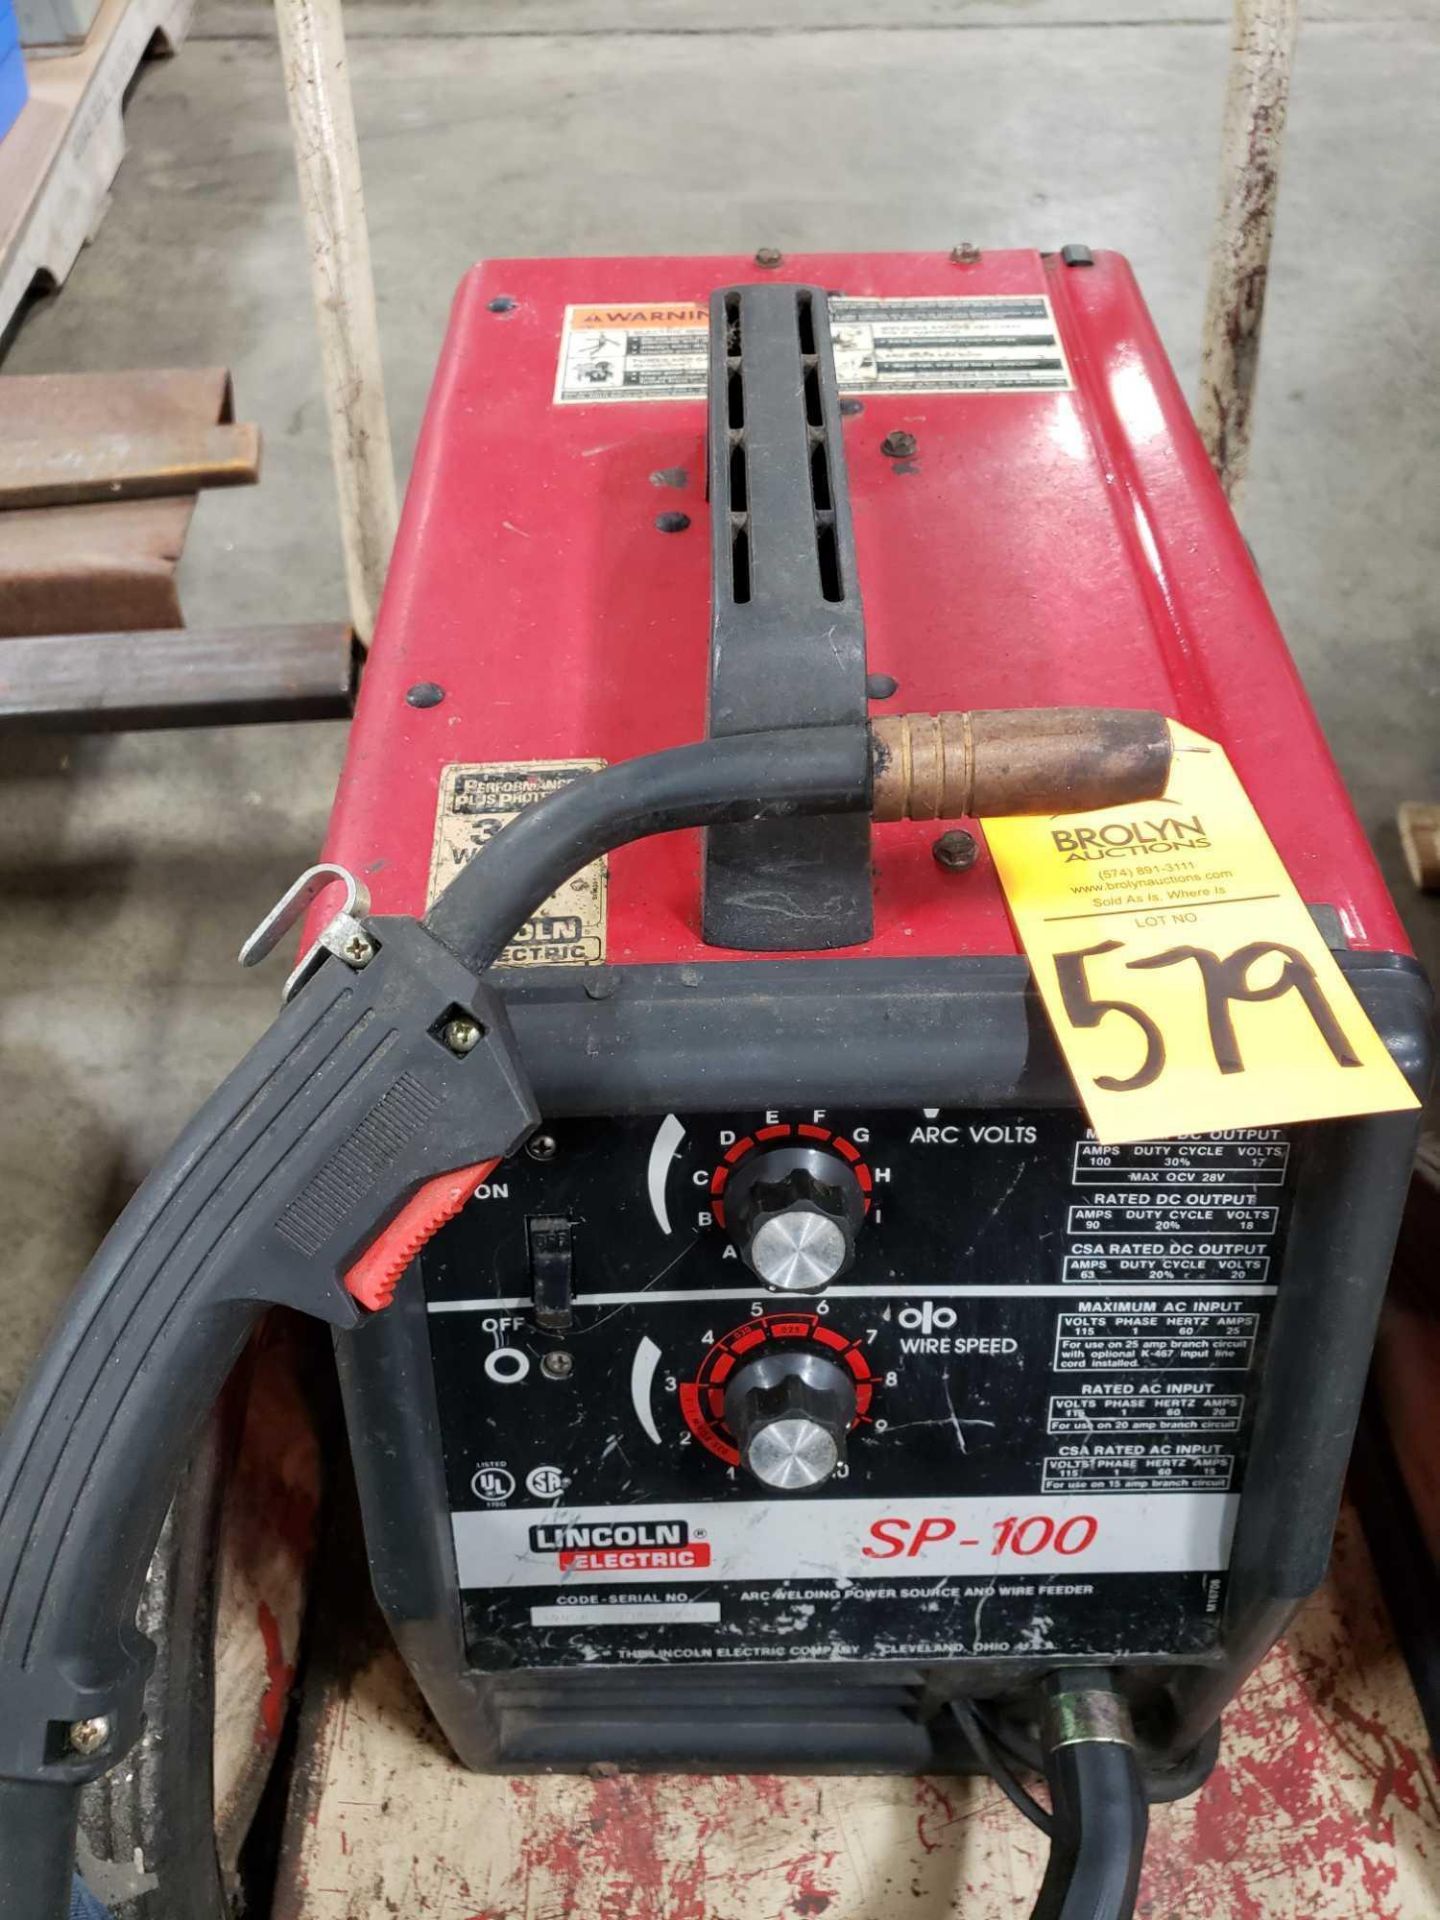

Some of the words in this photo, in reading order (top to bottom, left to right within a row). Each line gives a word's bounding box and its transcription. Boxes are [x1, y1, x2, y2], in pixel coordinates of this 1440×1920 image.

[607, 310, 709, 322] WARNIN
[470, 818, 502, 845] 3
[1051, 815, 1206, 852] BROLYN
[1065, 837, 1211, 863] AUCTIONS
[1098, 867, 1133, 882] (574)
[1137, 861, 1195, 876] 891-3111
[1093, 895, 1122, 908] Sold
[1126, 893, 1144, 904] As
[1167, 887, 1210, 901] Where
[1214, 885, 1226, 896] Is
[1134, 914, 1166, 928] LOT
[1171, 912, 1198, 926] NO
[502, 945, 586, 961] ECTRIC
[1053, 940, 1364, 1092] 579
[766, 1110, 779, 1124] E
[813, 1109, 826, 1123] F
[721, 1131, 736, 1145] D
[853, 1127, 869, 1143] G
[910, 1126, 959, 1144] ARC
[969, 1126, 1037, 1144] VOLTS
[1210, 1129, 1281, 1140] OUTPUT
[1082, 1146, 1120, 1155] AMPS
[1133, 1146, 1170, 1155] DUTY
[1178, 1146, 1223, 1155] CYCLE
[1238, 1147, 1281, 1156] VOLTS
[1090, 1157, 1111, 1166] 100
[1164, 1157, 1191, 1166] 30%
[1251, 1157, 1265, 1166] 17
[693, 1170, 709, 1186] C
[875, 1168, 890, 1182] H
[1129, 1173, 1158, 1182] MAX
[1166, 1173, 1195, 1182] OCV
[1201, 1173, 1225, 1182] 28V
[474, 1183, 509, 1199] ON
[1094, 1194, 1150, 1205] RATED
[1156, 1194, 1181, 1205] DC
[1186, 1194, 1256, 1205] OUTPUT
[699, 1212, 712, 1227] B
[875, 1209, 882, 1224] I
[1075, 1210, 1112, 1219] AMPS
[1126, 1210, 1162, 1219] DUTY
[1169, 1210, 1213, 1219] CYCLE
[1227, 1210, 1270, 1219] VOLTS
[1086, 1221, 1100, 1230] 90
[1155, 1221, 1180, 1230] 20%
[1240, 1221, 1253, 1230] 18
[722, 1244, 738, 1259] A
[1071, 1244, 1104, 1254] CSA
[1109, 1244, 1164, 1254] RATED
[1169, 1244, 1194, 1254] DC
[1198, 1244, 1267, 1254] OUTPUT
[1071, 1260, 1107, 1269] AMPS
[1120, 1260, 1155, 1269] DUTY
[1163, 1260, 1206, 1269] CYCLE
[1218, 1260, 1261, 1269] VOLTS
[1149, 1270, 1174, 1279] 20%
[1231, 1270, 1246, 1279] 20
[751, 1302, 763, 1317] 5
[816, 1300, 829, 1315] 6
[1078, 1302, 1156, 1313] MAXIMUM
[1163, 1302, 1187, 1312] AC
[1193, 1302, 1243, 1312] INPUT
[481, 1316, 525, 1332] OFF
[1065, 1317, 1106, 1326] VOLTS
[1115, 1317, 1158, 1326] PHASE
[1166, 1317, 1209, 1326] HERTZ
[1217, 1317, 1253, 1326] AMPS
[701, 1330, 714, 1344] 4
[866, 1329, 878, 1344] 7
[1075, 1328, 1094, 1336] 115
[1179, 1328, 1194, 1336] 60
[900, 1338, 950, 1354] WIRE
[954, 1338, 1017, 1354] SPEED
[1062, 1340, 1081, 1349] For
[1125, 1340, 1139, 1349] 25
[1143, 1341, 1167, 1351] amp
[1171, 1340, 1209, 1349] branch
[1213, 1340, 1247, 1348] circuit
[1061, 1350, 1085, 1358] with
[1091, 1350, 1135, 1360] optional
[1180, 1349, 1209, 1359] input
[1214, 1349, 1235, 1357] line
[1061, 1359, 1085, 1367] cord
[665, 1377, 677, 1392] 3
[885, 1372, 897, 1387] 8
[1081, 1384, 1134, 1395] RATED
[1139, 1384, 1161, 1394] AC
[1166, 1383, 1214, 1394] INPUT
[1056, 1400, 1096, 1408] VOLTS
[1104, 1400, 1145, 1408] PHASE
[1154, 1400, 1196, 1408] HERTZ
[1203, 1400, 1238, 1408] AMPS
[875, 1419, 888, 1433] 9
[1051, 1421, 1071, 1429] For
[1132, 1422, 1155, 1431] amp
[1160, 1420, 1198, 1428] branch
[1201, 1420, 1236, 1428] circuit
[680, 1431, 691, 1445] 2
[1059, 1446, 1090, 1456] CSA
[1094, 1446, 1145, 1455] RATED
[1150, 1446, 1171, 1455] AC
[1176, 1445, 1223, 1455] INPUT
[1097, 1459, 1137, 1467] PHASE
[1146, 1459, 1186, 1467] HERTZ
[726, 1467, 735, 1480] 1
[480, 1474, 507, 1495] UL
[536, 1524, 682, 1548] LINCOLN
[862, 1515, 1098, 1559] SP-100
[574, 1552, 696, 1569] ELECTRIC
[741, 1591, 769, 1600] ARC
[771, 1589, 841, 1600] WELDING
[845, 1589, 896, 1600] POWER
[900, 1588, 960, 1599] SOURCE
[964, 1587, 995, 1597] AND
[999, 1586, 1034, 1596] WIRE
[1038, 1585, 1094, 1596] FEEDER
[716, 1648, 787, 1658] ELECTRIC
[790, 1645, 859, 1656] COMPANY
[973, 1641, 1010, 1651] OHIO
